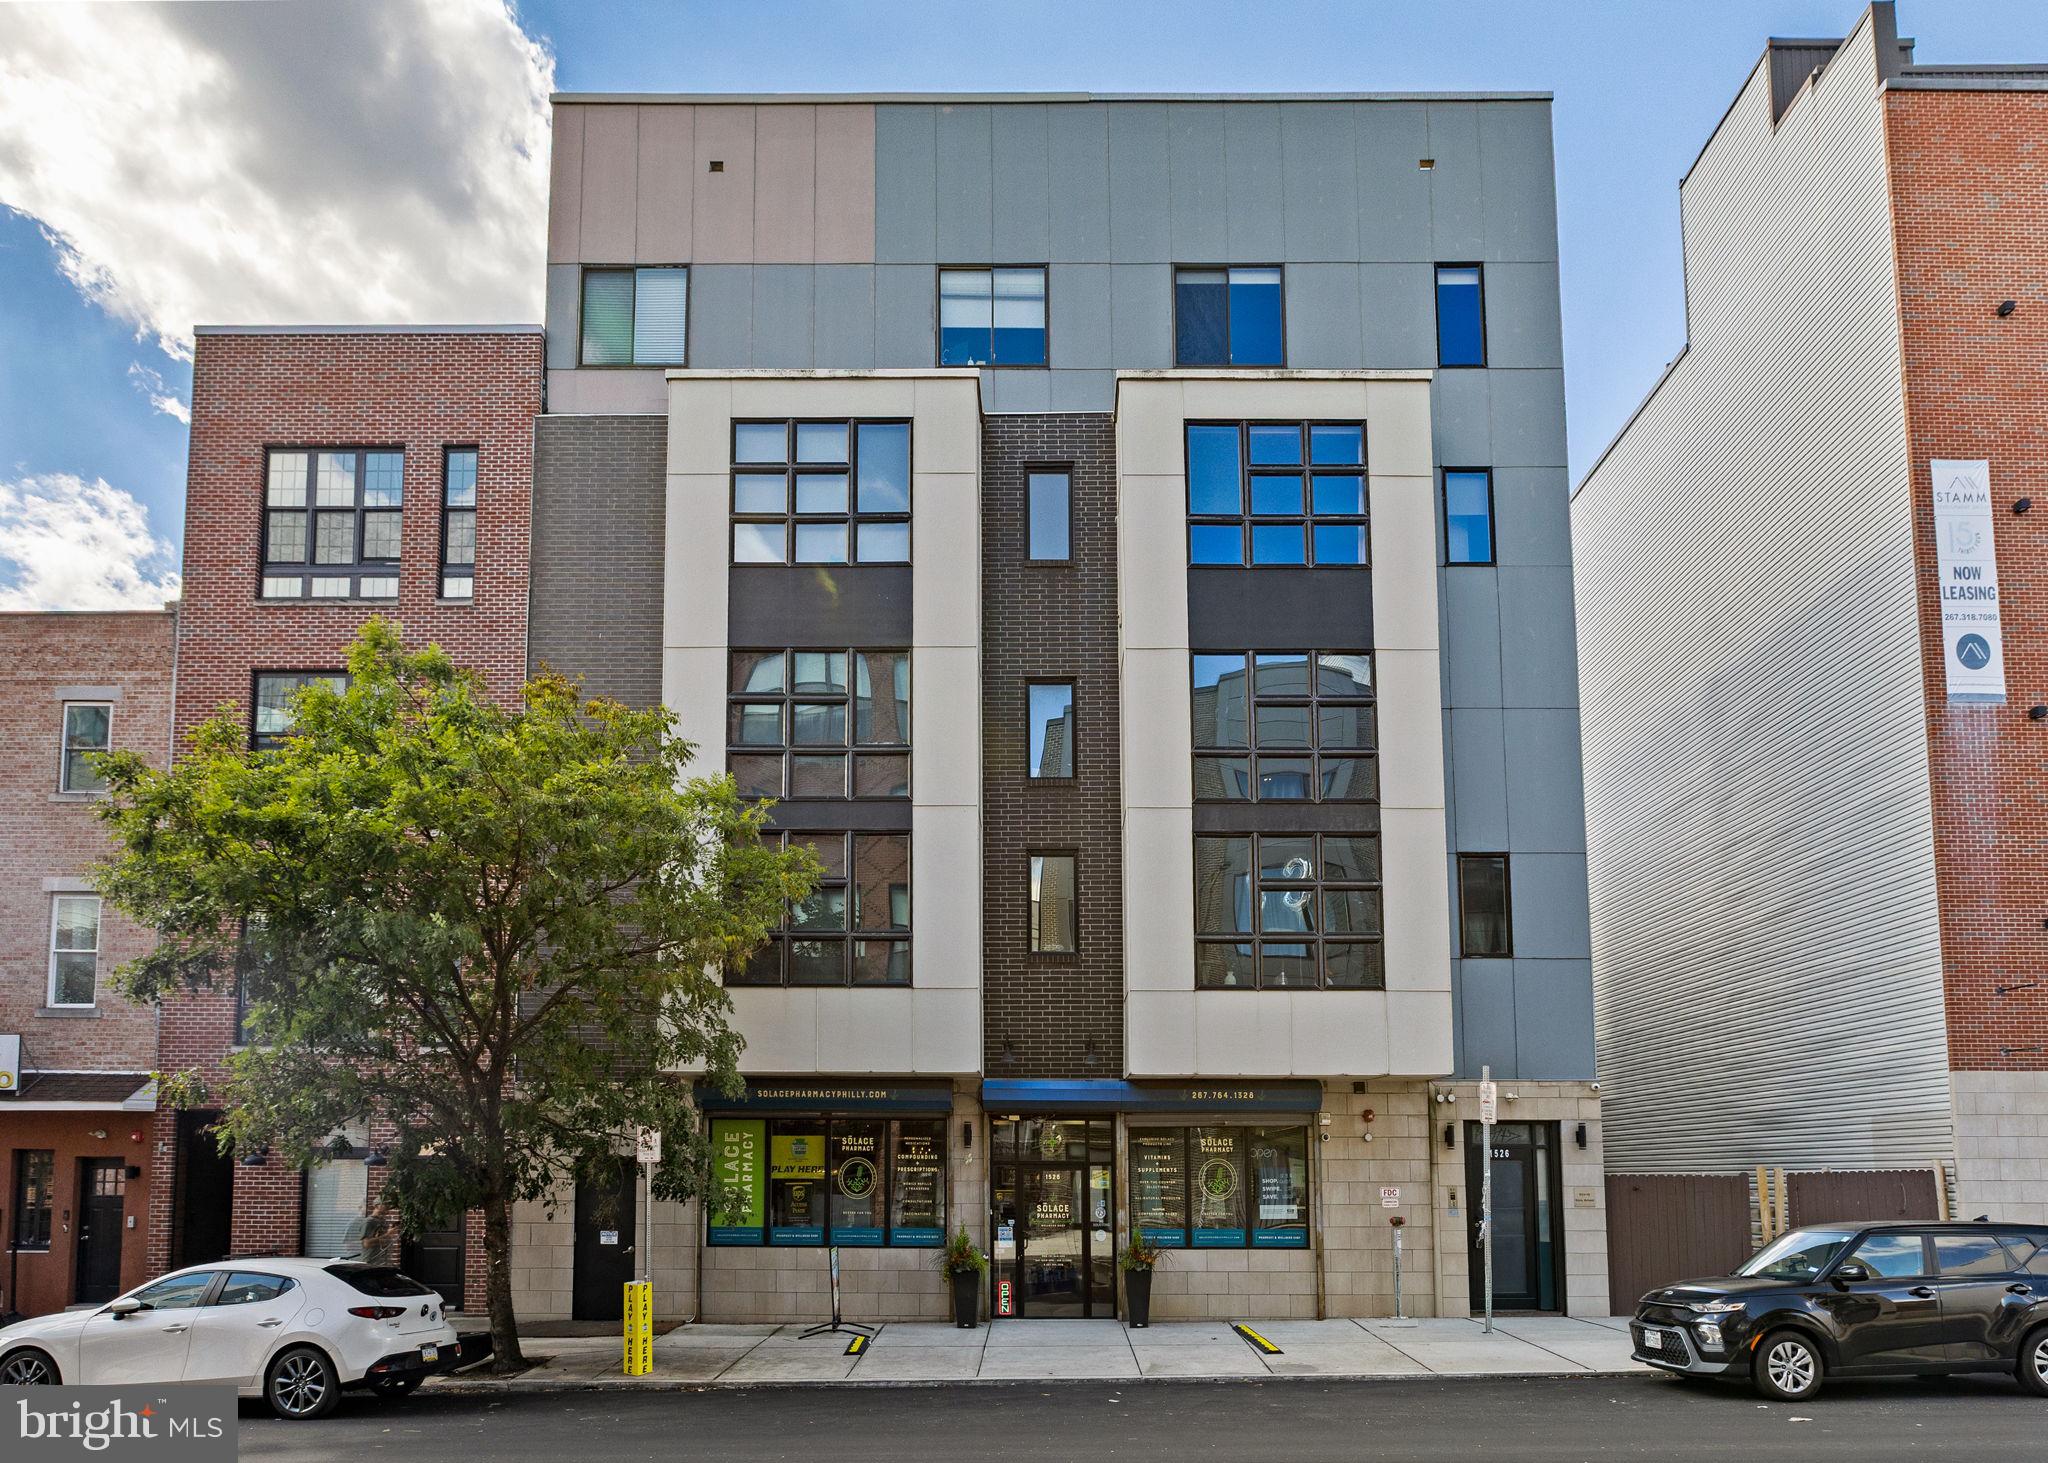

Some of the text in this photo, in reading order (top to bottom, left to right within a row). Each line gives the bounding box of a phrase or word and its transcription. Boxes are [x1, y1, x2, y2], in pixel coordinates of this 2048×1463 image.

[1936, 491, 1987, 503] STAMM
[1953, 566, 1982, 581] NOW
[1942, 586, 1996, 601] LEASING
[757, 1090, 887, 1099] SOLACEPHARMACYPHILLY.COM
[1192, 1091, 1254, 1099] 267.764.1328
[1489, 1149, 1510, 1158] 1526
[771, 1165, 825, 1174] PLAY HERE
[1001, 1283, 1010, 1313] OPEN
